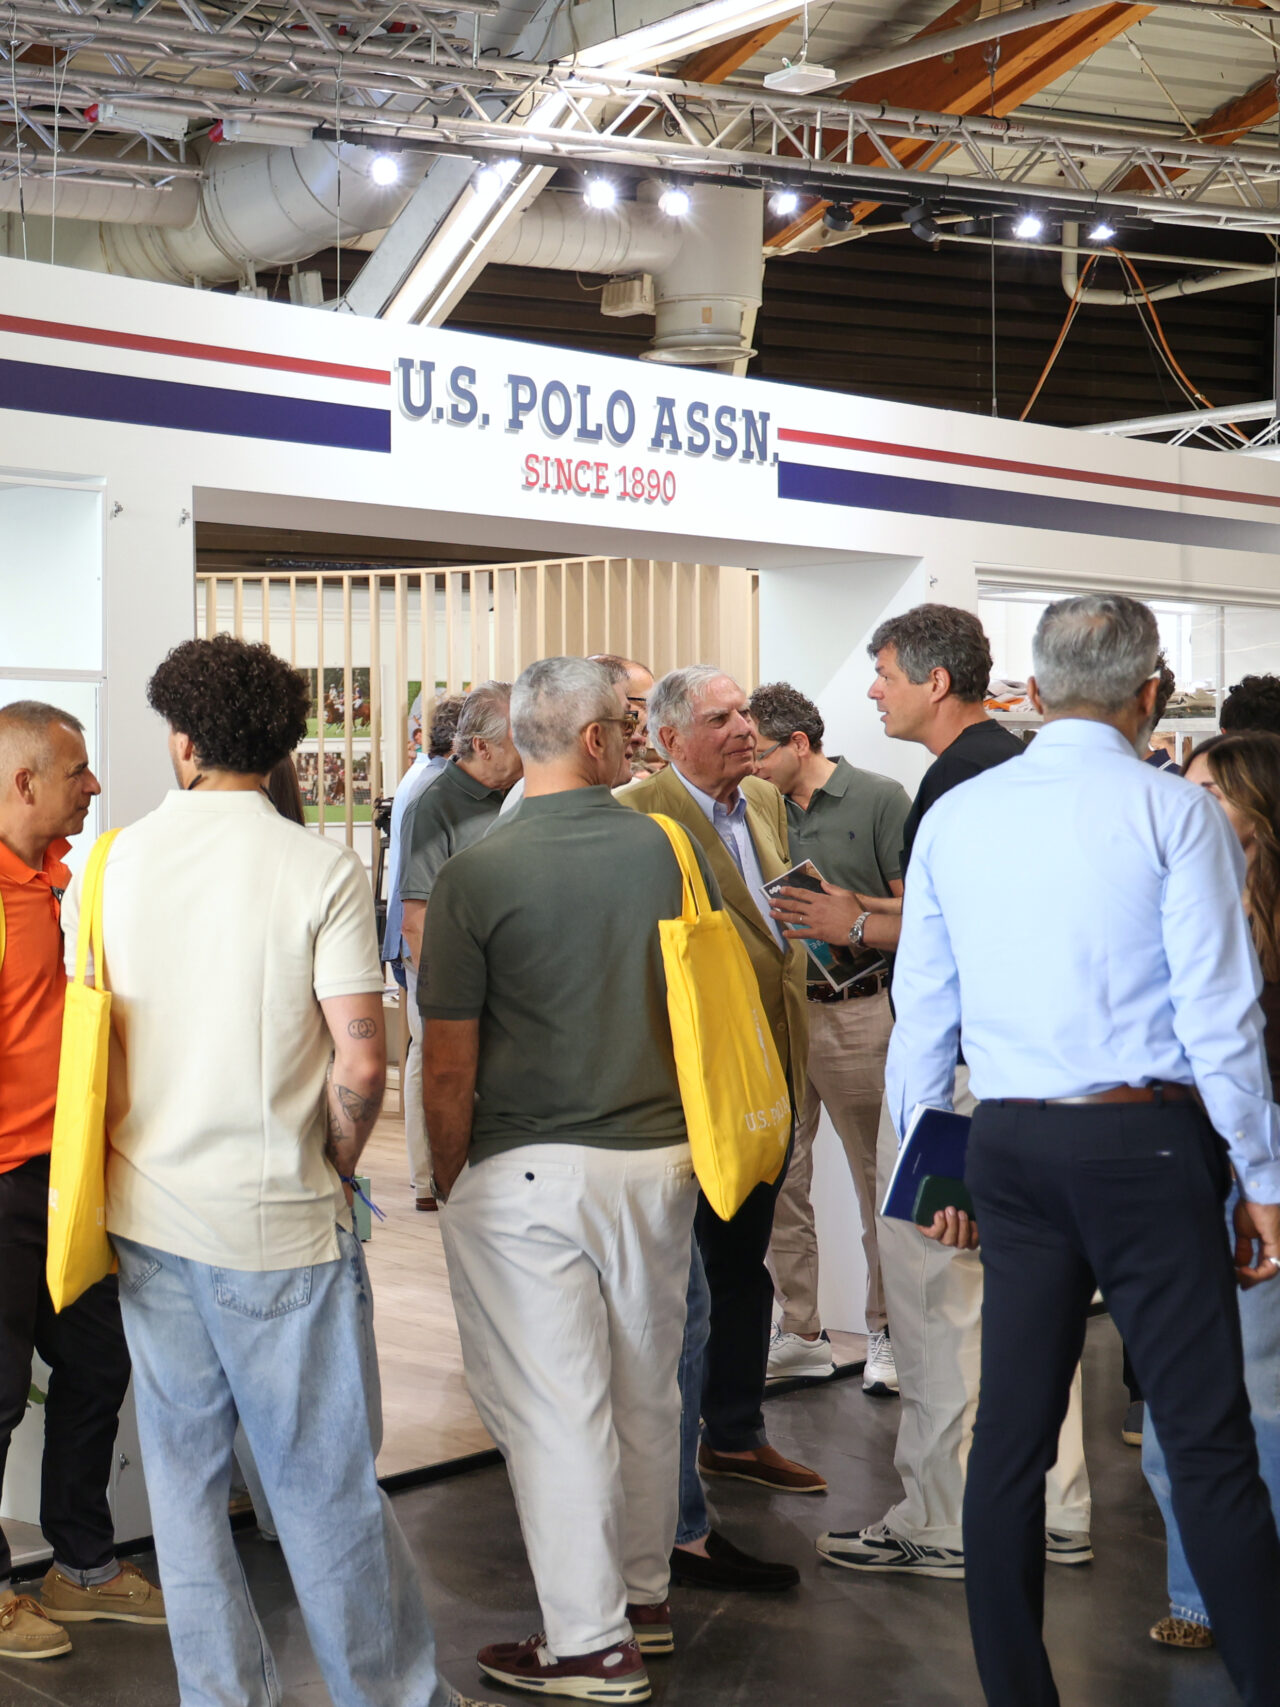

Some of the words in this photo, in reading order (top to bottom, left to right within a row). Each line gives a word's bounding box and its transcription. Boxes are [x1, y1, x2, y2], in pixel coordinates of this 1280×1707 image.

[396, 356, 490, 427] U.S.
[506, 373, 637, 446] POLO
[650, 395, 780, 464] ASSN.
[524, 453, 610, 495] SINCE
[618, 465, 677, 503] 1890
[743, 1109, 770, 1132] US.
